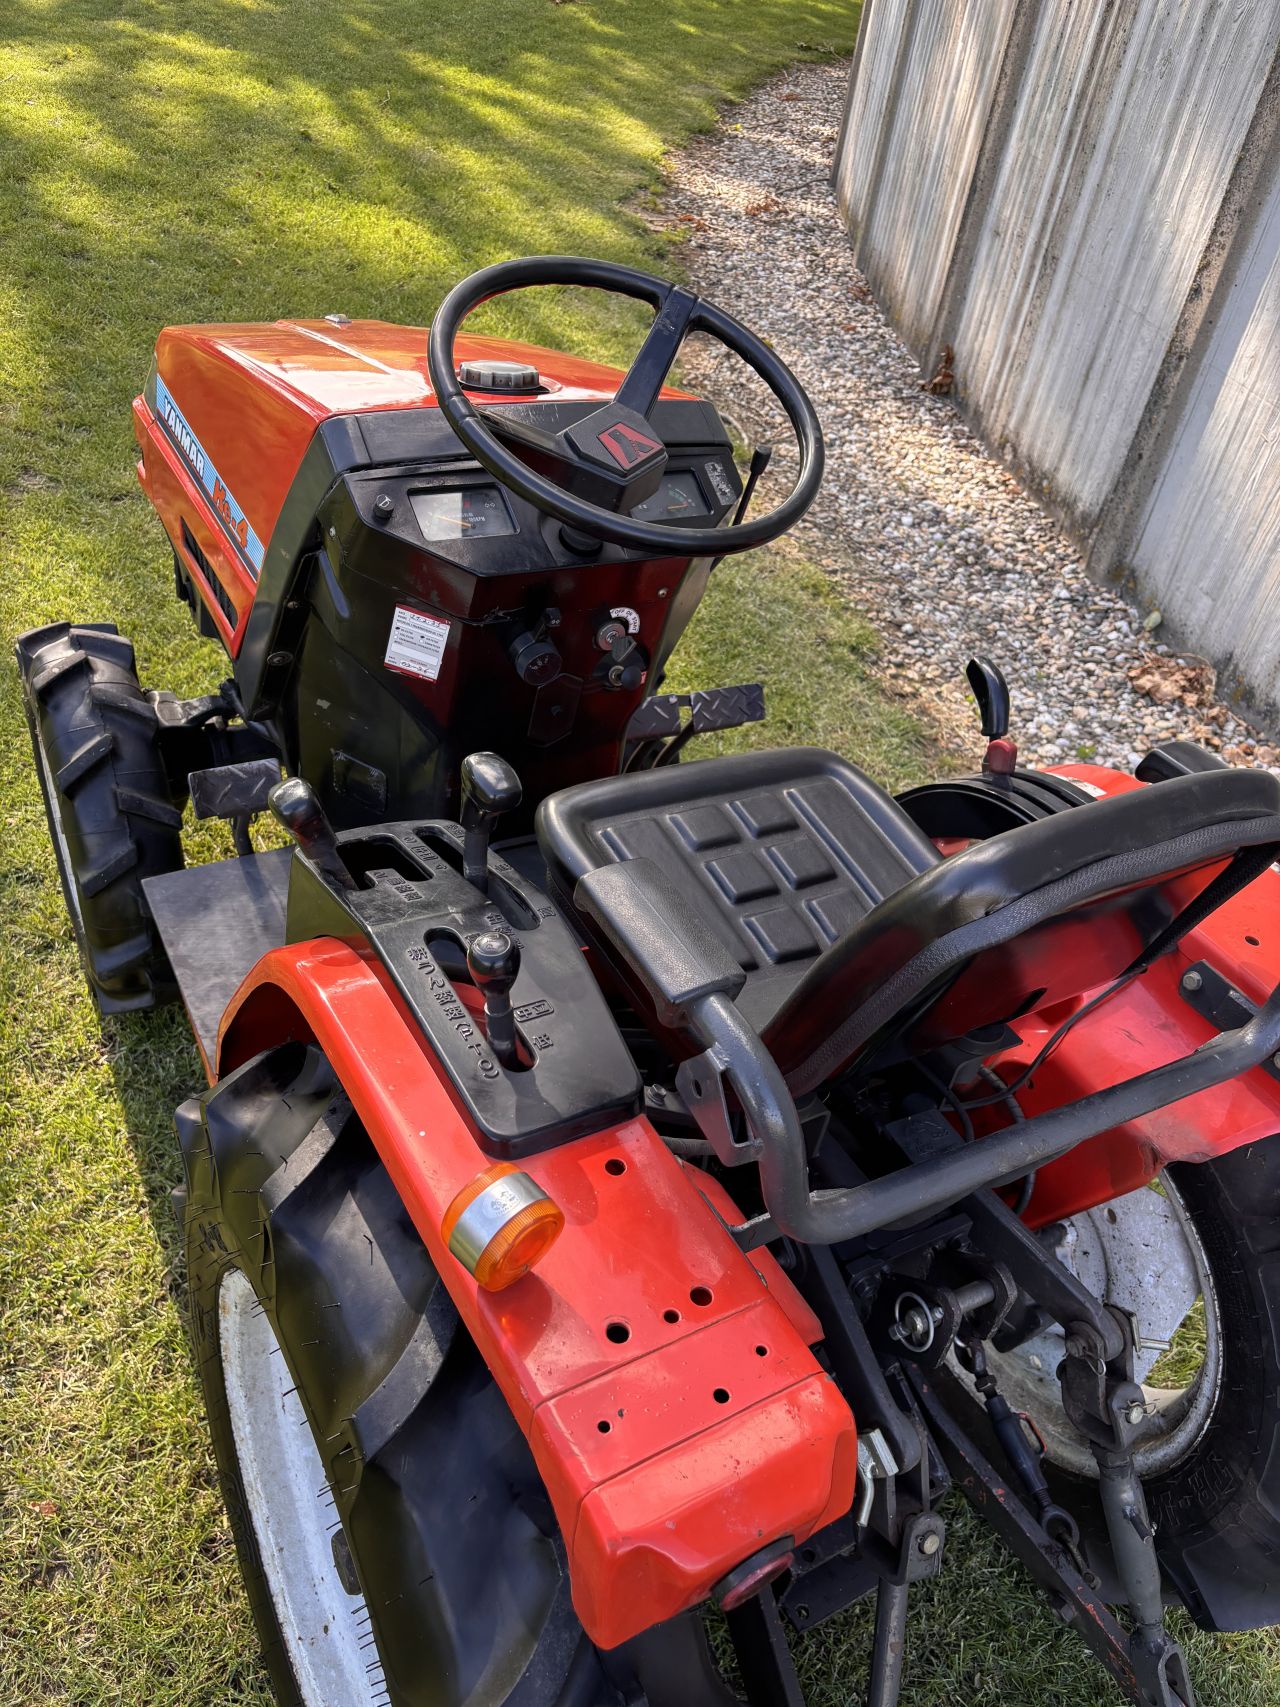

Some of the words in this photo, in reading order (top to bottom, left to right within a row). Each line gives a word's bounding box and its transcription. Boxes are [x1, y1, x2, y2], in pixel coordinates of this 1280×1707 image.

[164, 396, 205, 479] YANMAR
[516, 1002, 551, 1018] 中立
[533, 1033, 554, 1051] 低
